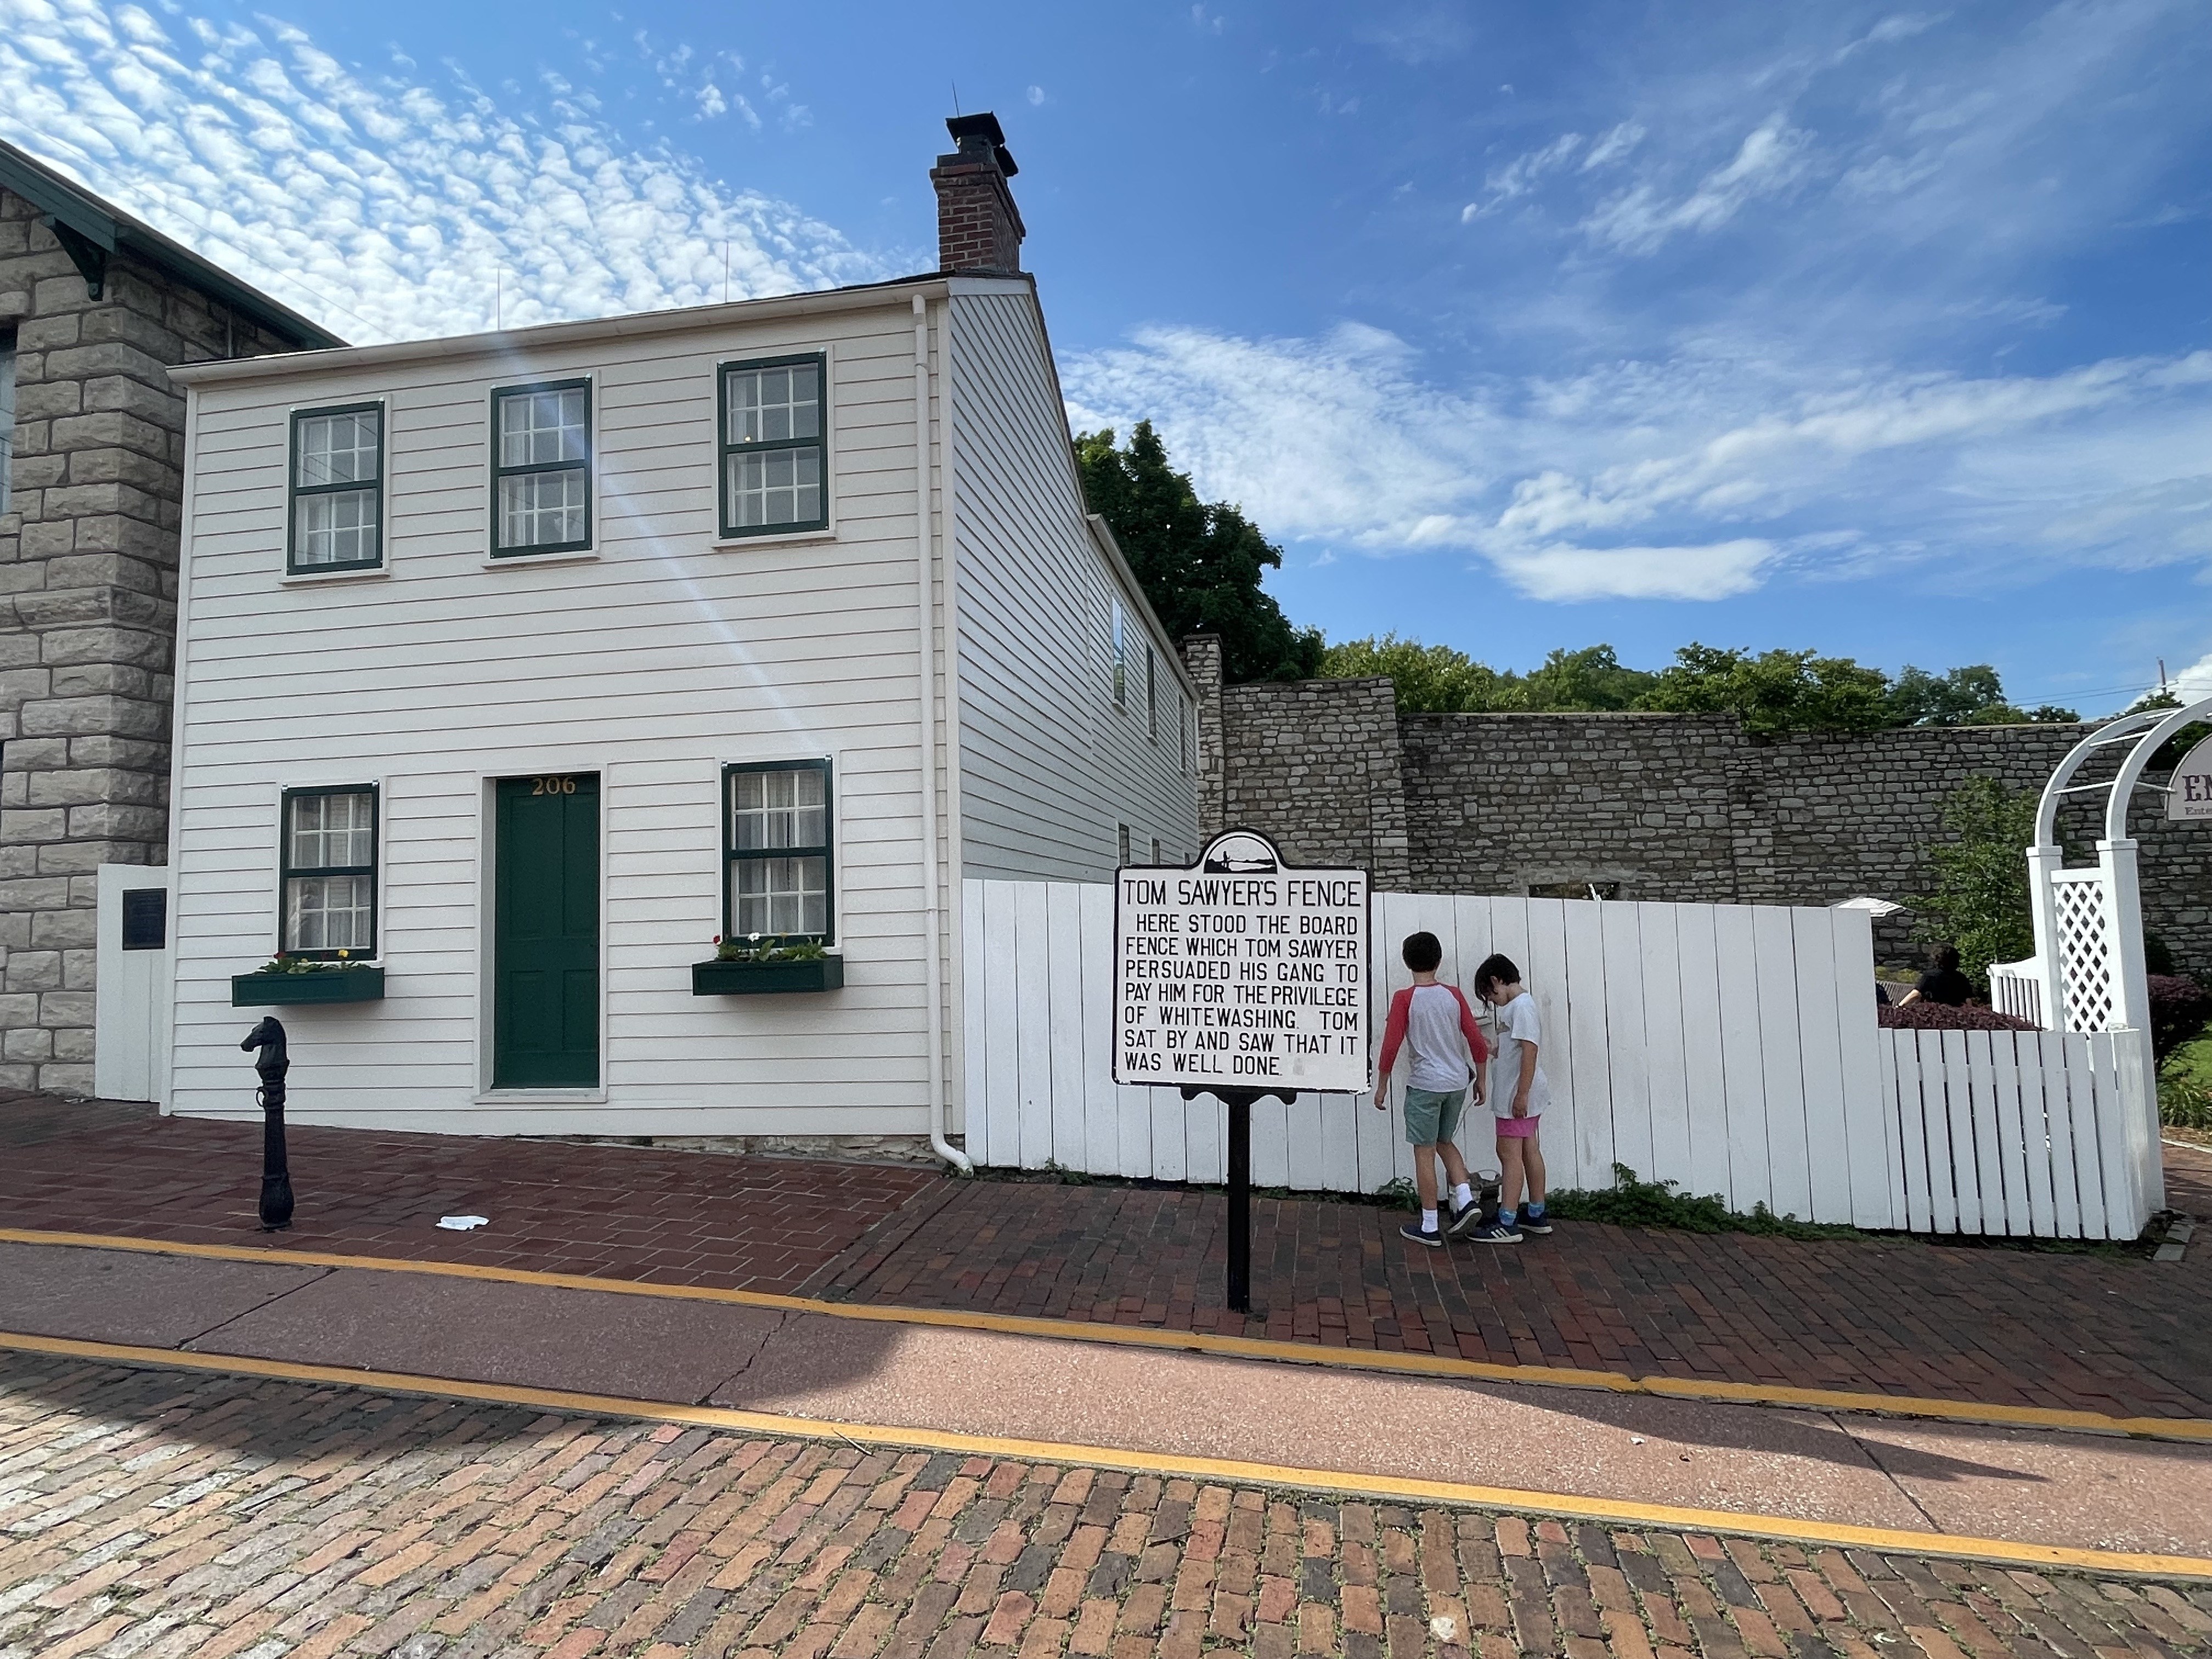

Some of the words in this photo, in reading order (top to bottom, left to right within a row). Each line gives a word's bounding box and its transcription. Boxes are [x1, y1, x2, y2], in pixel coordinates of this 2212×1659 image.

[532, 776, 575, 795] 206
[1124, 879, 1166, 905] TOM
[1178, 880, 1277, 906] SAWYER'S
[1288, 881, 1361, 906] FENCE
[1137, 913, 1179, 932] HERE
[1188, 914, 1246, 933] STOOD
[1256, 915, 1290, 934] THE
[1300, 916, 1357, 935] BOARD
[1126, 936, 1178, 955] FENCE
[1186, 938, 1237, 956] WHICH
[1245, 939, 1280, 957] TOM
[1288, 939, 1357, 959] SAWYER
[1126, 960, 1230, 979] PERSUADED
[1240, 962, 1267, 980] HIS
[1277, 962, 1324, 982] GANG
[1335, 963, 1358, 983] TO
[1126, 983, 1152, 1001] PAY
[1159, 983, 1186, 1002] HIM
[1193, 984, 1224, 1003] FOR
[1234, 985, 1267, 1004] THE
[1271, 986, 1358, 1007] PRIVILEGE
[1125, 1006, 1147, 1024] OF
[1159, 1006, 1300, 1029] WHITEWASHING.
[1319, 1011, 1358, 1031] TOM
[1125, 1029, 1156, 1048] SAT
[1166, 1030, 1188, 1048] BY
[1195, 1031, 1229, 1050] AND
[1239, 1032, 1274, 1052] SAW
[1284, 1034, 1331, 1053] THAT
[1341, 1036, 1358, 1055] IT
[1125, 1052, 1161, 1071] WAS
[1172, 1053, 1223, 1074] WELL
[1233, 1055, 1283, 1076] DONE.
